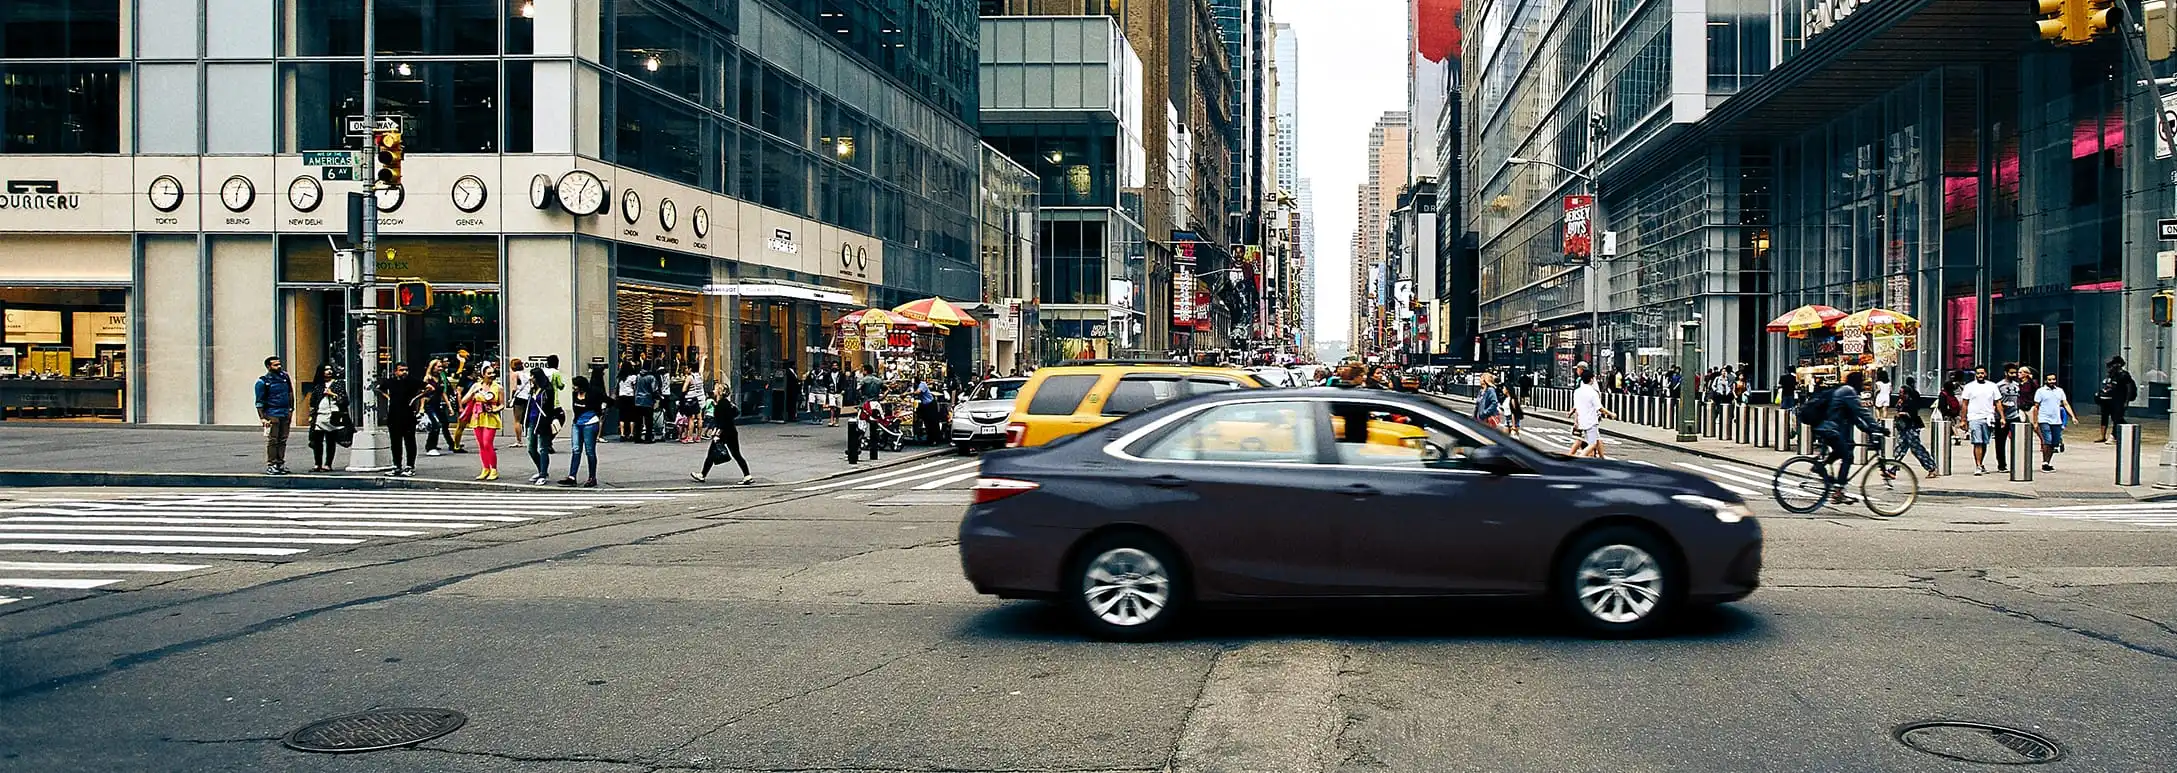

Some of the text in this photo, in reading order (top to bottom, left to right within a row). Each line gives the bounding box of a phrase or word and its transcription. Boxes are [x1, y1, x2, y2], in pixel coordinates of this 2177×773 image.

[376, 121, 393, 130] WAY
[308, 156, 351, 165] AMERICAS
[327, 169, 336, 179] 6
[1564, 206, 1591, 222] JERSEY
[155, 217, 178, 225] TOKYO
[456, 218, 484, 226] GENEVA
[1567, 220, 1587, 234] BOYS
